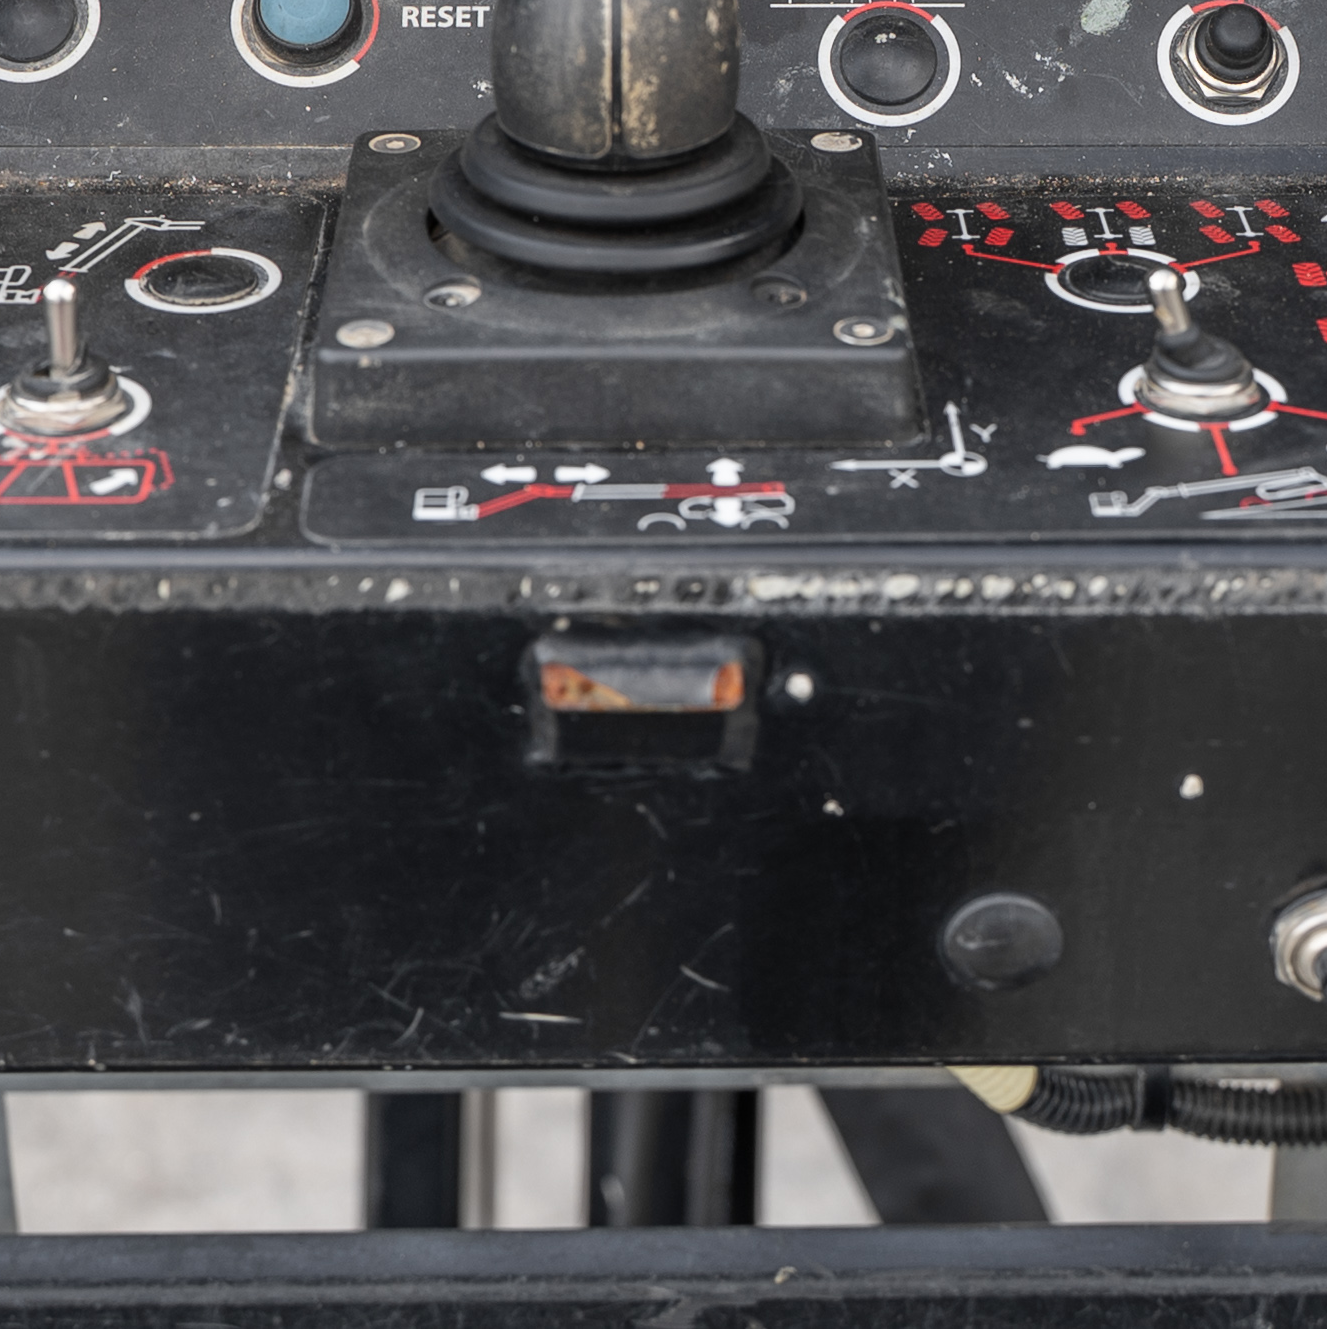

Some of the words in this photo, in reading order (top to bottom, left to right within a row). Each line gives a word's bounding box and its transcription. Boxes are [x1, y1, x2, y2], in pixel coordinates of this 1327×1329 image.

[401, 5, 491, 28] RESET
[969, 423, 998, 443] Y
[887, 468, 920, 489] X
